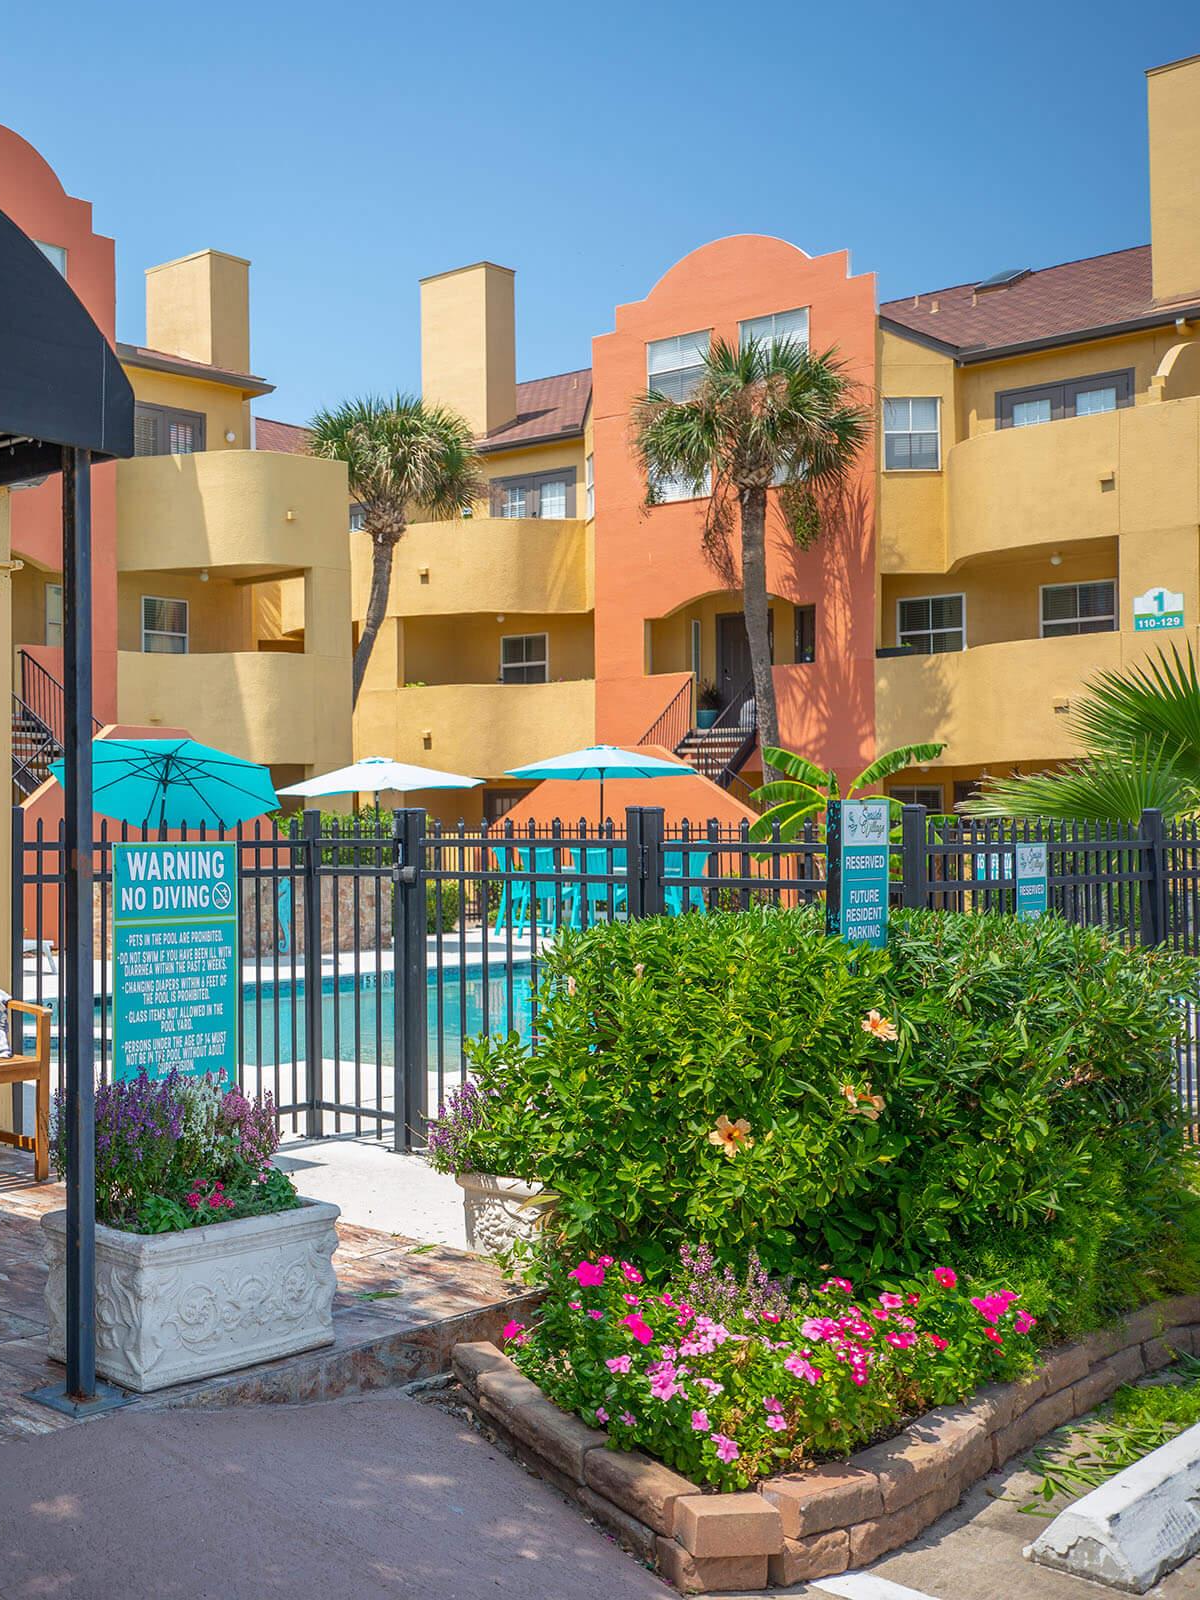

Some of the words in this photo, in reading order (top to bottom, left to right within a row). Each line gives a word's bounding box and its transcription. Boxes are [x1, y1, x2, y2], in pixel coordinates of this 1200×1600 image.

[1153, 592, 1164, 612] 1
[1138, 617, 1180, 628] 110-129
[126, 851, 224, 881] WARNING
[846, 855, 885, 870] RESERVED
[121, 887, 146, 912] NO
[152, 885, 209, 910] DIVING
[850, 889, 880, 904] FUTURE
[846, 906, 883, 922] RESIDENT
[144, 934, 150, 945] IN
[152, 933, 161, 945] THE
[163, 932, 177, 944] POOL
[179, 931, 190, 944] ARE
[191, 930, 223, 943] PROHIBITED.
[848, 924, 880, 940] PARKING
[129, 952, 140, 964] NOT
[142, 950, 158, 963] SWIM
[160, 950, 165, 961] IF
[166, 949, 178, 961] YOU
[180, 948, 193, 960] HAVE
[194, 947, 208, 959] BEEN
[218, 946, 232, 958] WITH
[125, 964, 153, 977] DIARRHEA
[154, 962, 174, 975] WITHIN
[176, 961, 185, 973] THE
[187, 960, 201, 972] PAST
[202, 960, 206, 971] 2
[207, 959, 228, 971] WEEKS.
[125, 980, 154, 993] CHANGING
[156, 978, 180, 991] DIAPERS
[181, 977, 200, 989] WITHIN
[206, 975, 218, 987] FEET
[220, 975, 227, 986] OF
[143, 993, 153, 1005] THE
[154, 992, 169, 1004] POOL
[171, 991, 176, 1002] IS
[129, 1010, 148, 1023] GLASS
[149, 1009, 166, 1022] ITEMS
[167, 1008, 178, 1020] NOT
[180, 1005, 205, 1018] ALLOWED
[207, 1004, 212, 1016] IN
[214, 1003, 223, 1015] THE
[161, 1020, 175, 1032] POOL
[177, 1019, 193, 1030] YARD.
[125, 1040, 151, 1053] PERSONS
[153, 1037, 171, 1050] UNDER
[173, 1036, 183, 1048] THE
[184, 1034, 195, 1046] AGE
[196, 1033, 203, 1045] OF
[212, 1031, 226, 1043] MUST
[126, 1054, 137, 1066] NOT
[139, 1052, 146, 1064] BE
[166, 1049, 181, 1061] POOL
[183, 1046, 207, 1058] WITHOUT
[208, 1044, 225, 1056] ADULT
